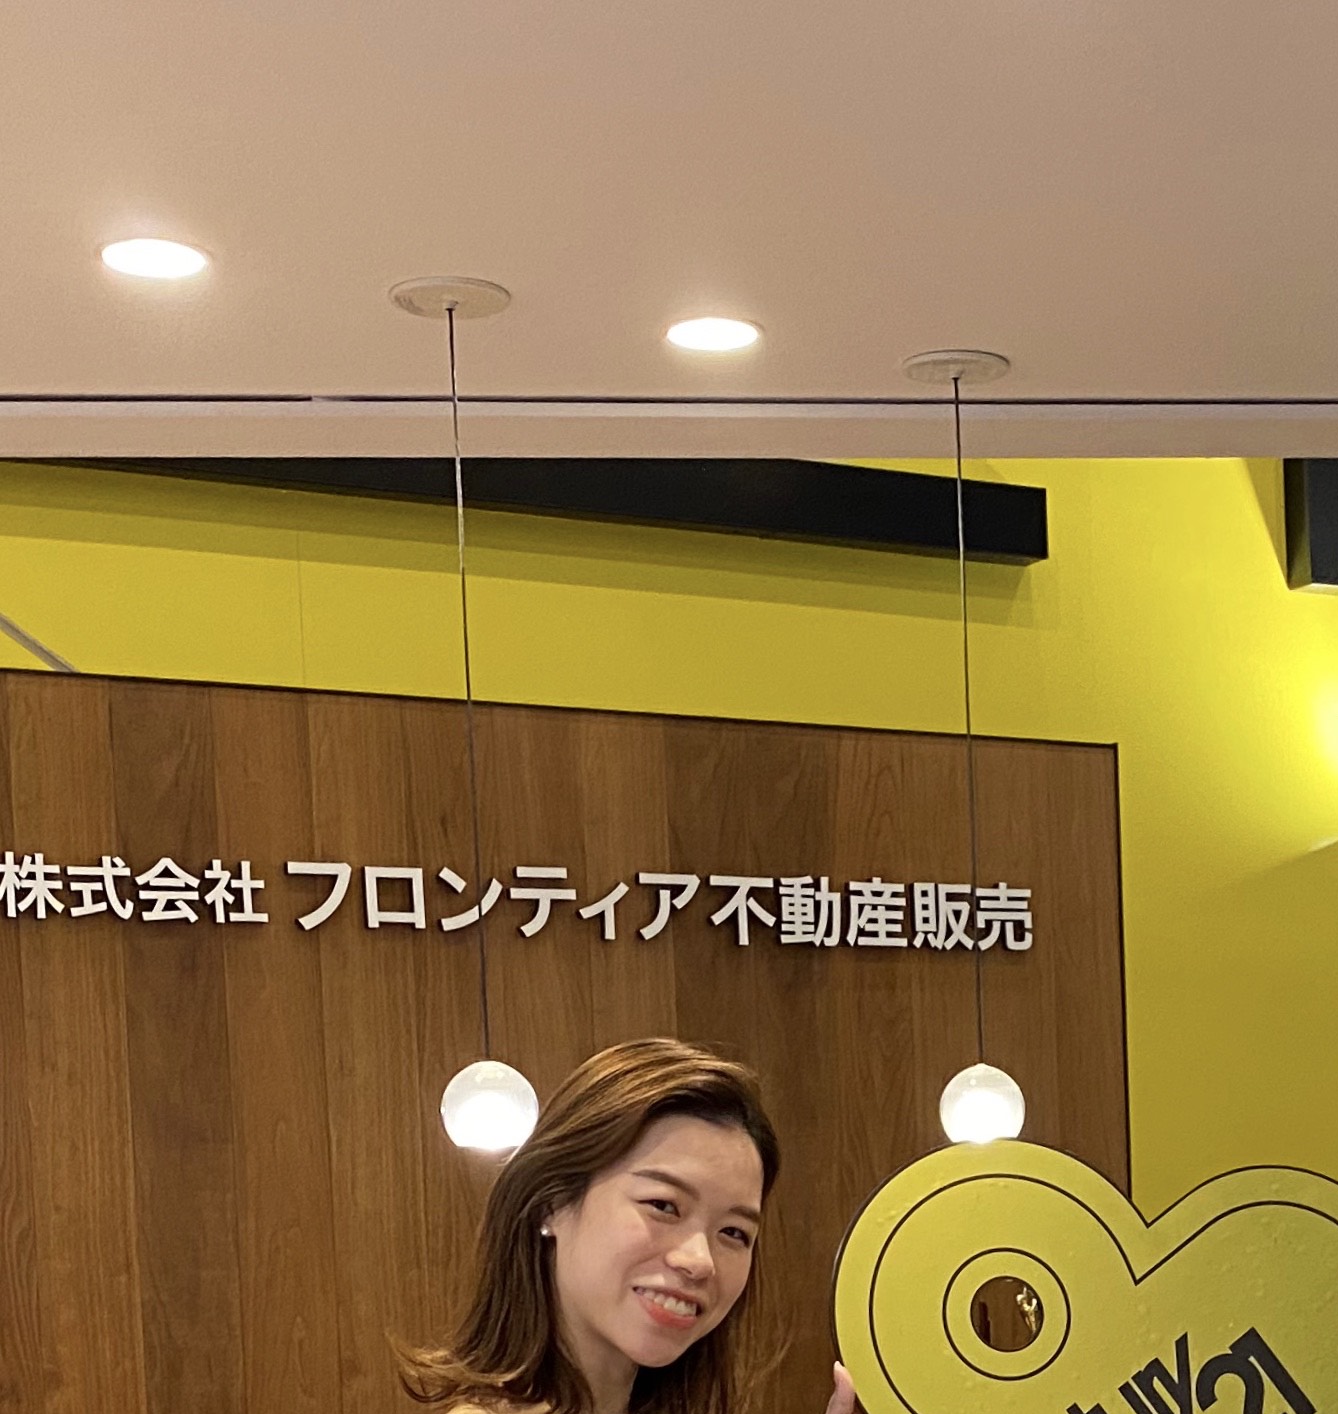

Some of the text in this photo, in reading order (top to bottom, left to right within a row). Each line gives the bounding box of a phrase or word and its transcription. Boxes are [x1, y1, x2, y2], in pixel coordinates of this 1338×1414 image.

[0, 851, 1033, 951] 株式会社 フロンティア不動産販売
